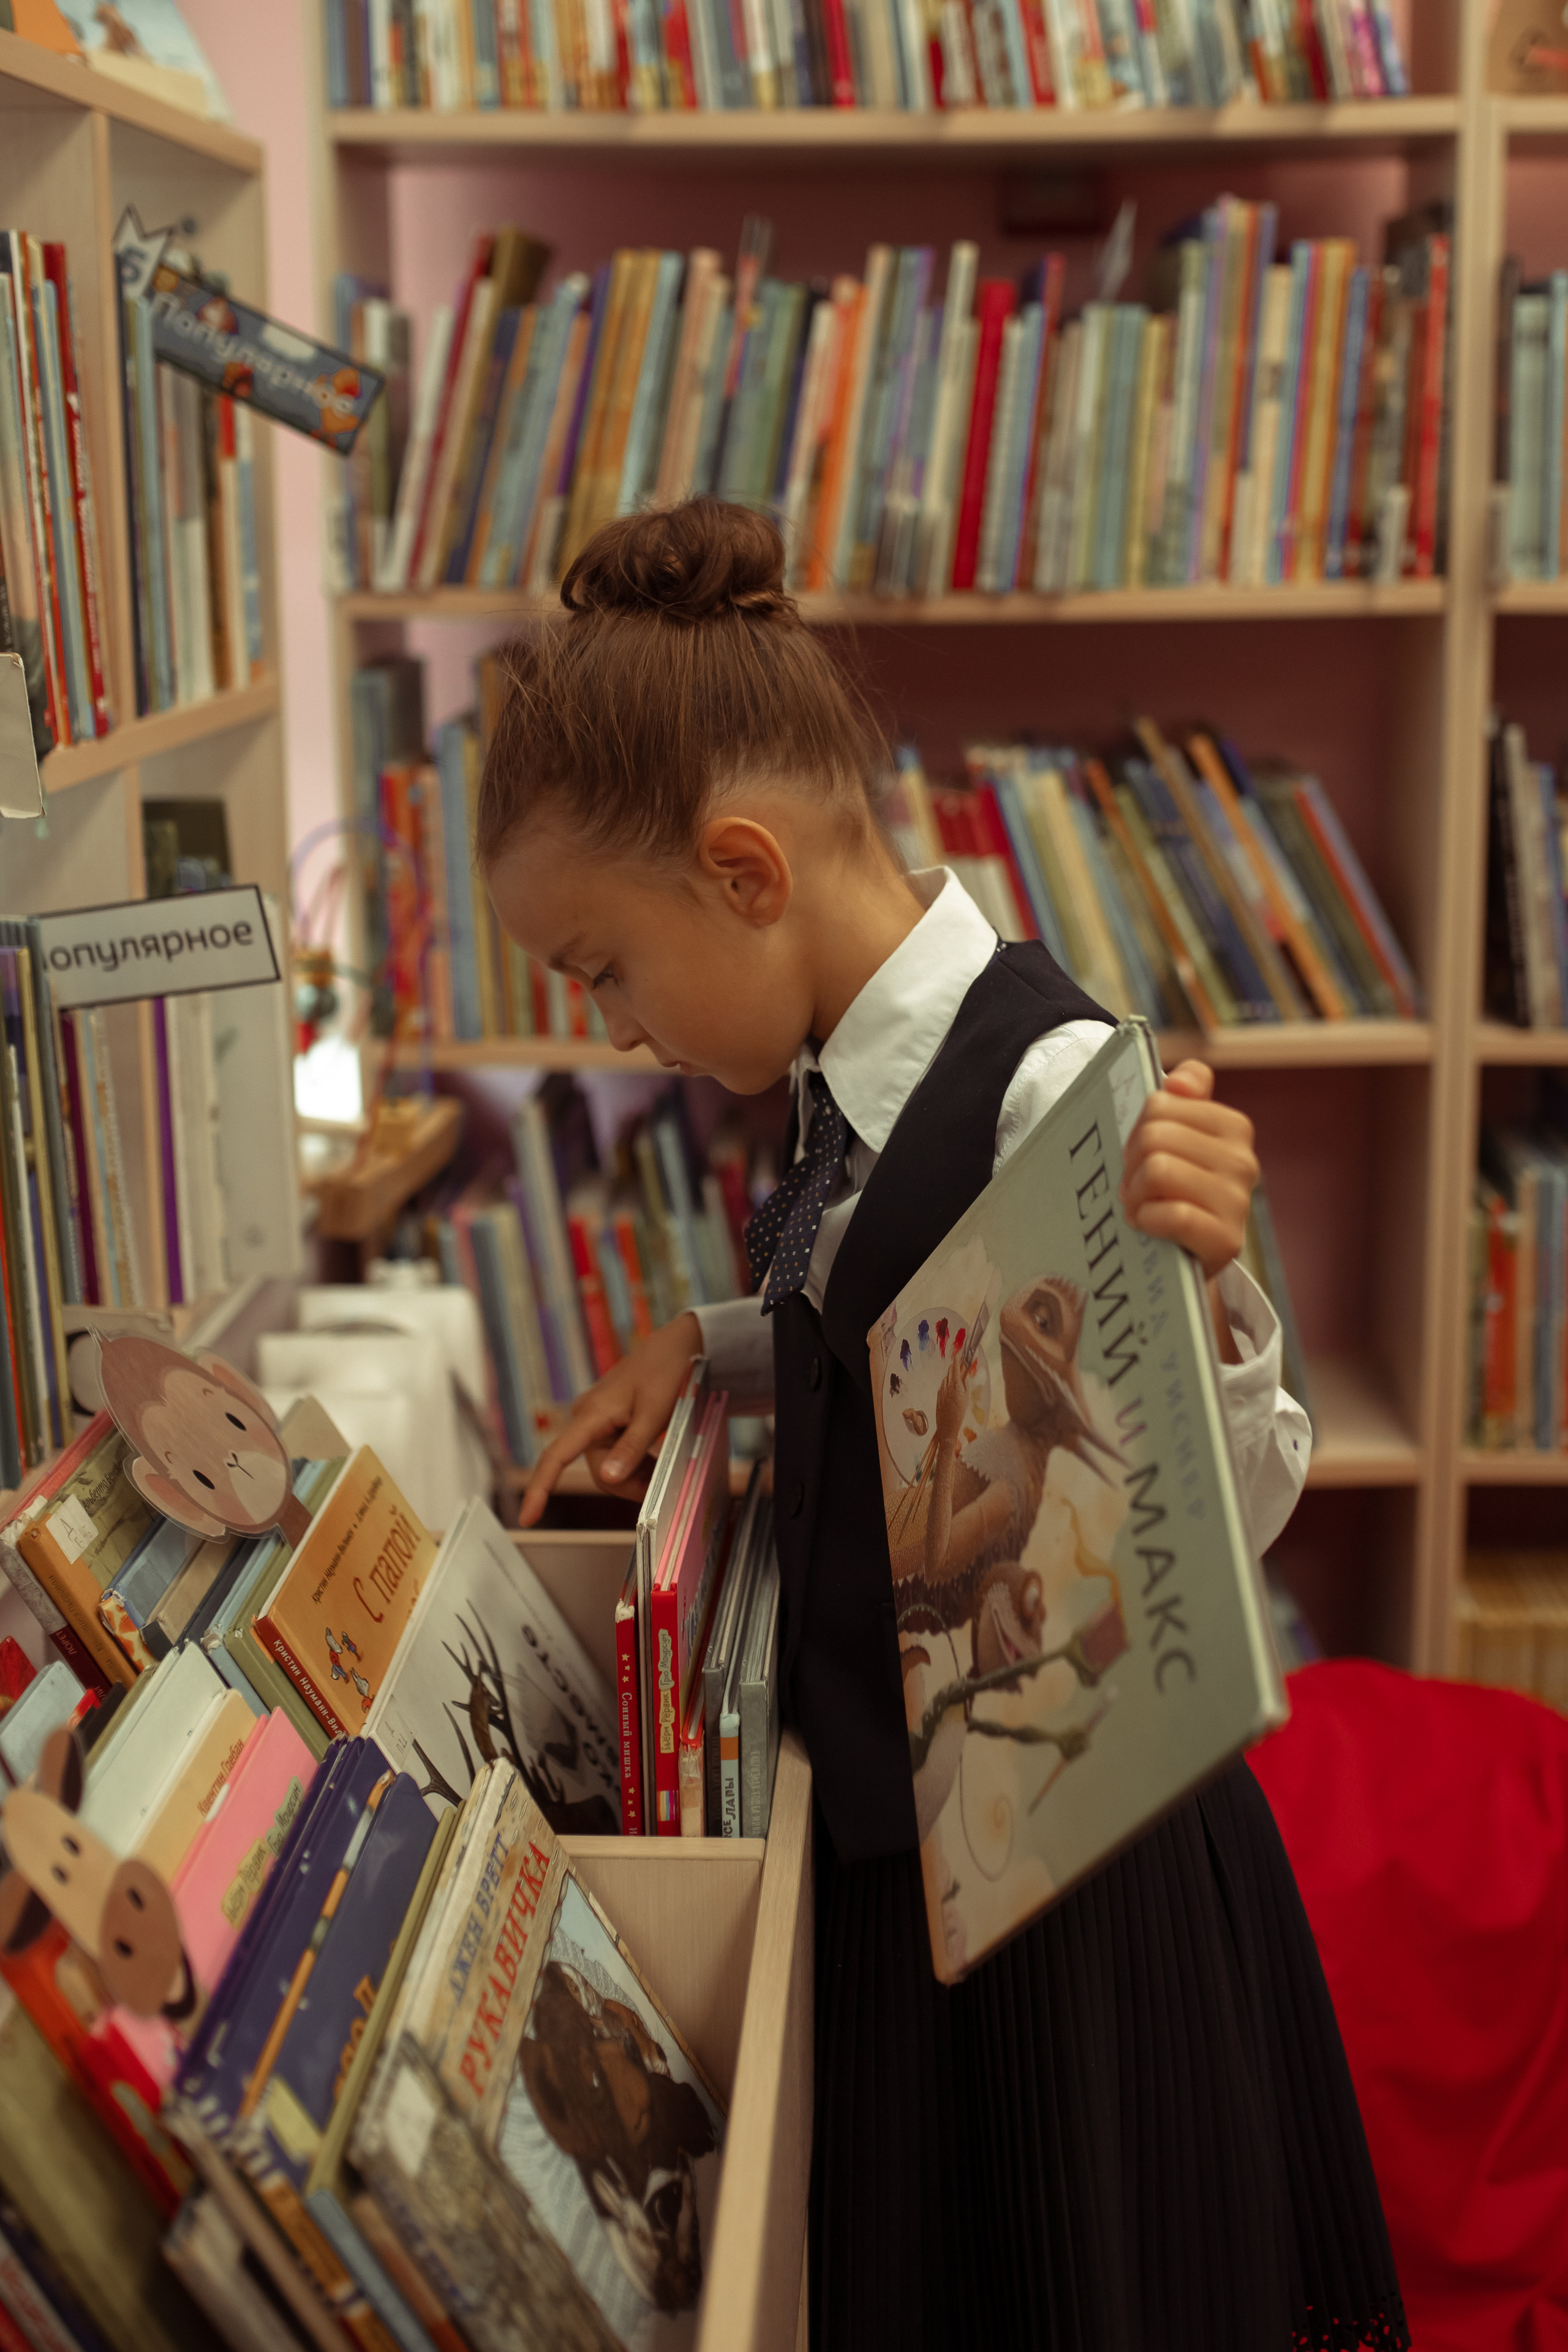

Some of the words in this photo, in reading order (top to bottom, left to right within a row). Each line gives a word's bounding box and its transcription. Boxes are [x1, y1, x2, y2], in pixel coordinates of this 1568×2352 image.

[42, 921, 254, 972] опулярное
[1068, 1120, 1149, 1388] ГЕНИЙ
[1123, 1463, 1198, 1694] МАКС
[369, 1504, 421, 1606] папой
[273, 1638, 301, 1676] Кристин
[621, 1692, 633, 1737] Сонный
[725, 1777, 736, 1820] ЛАПЫ
[448, 1911, 484, 2008] ДЖЕН
[476, 1831, 509, 1919] БРЕТТ
[458, 1841, 551, 2099] РУКАВИЧКА
